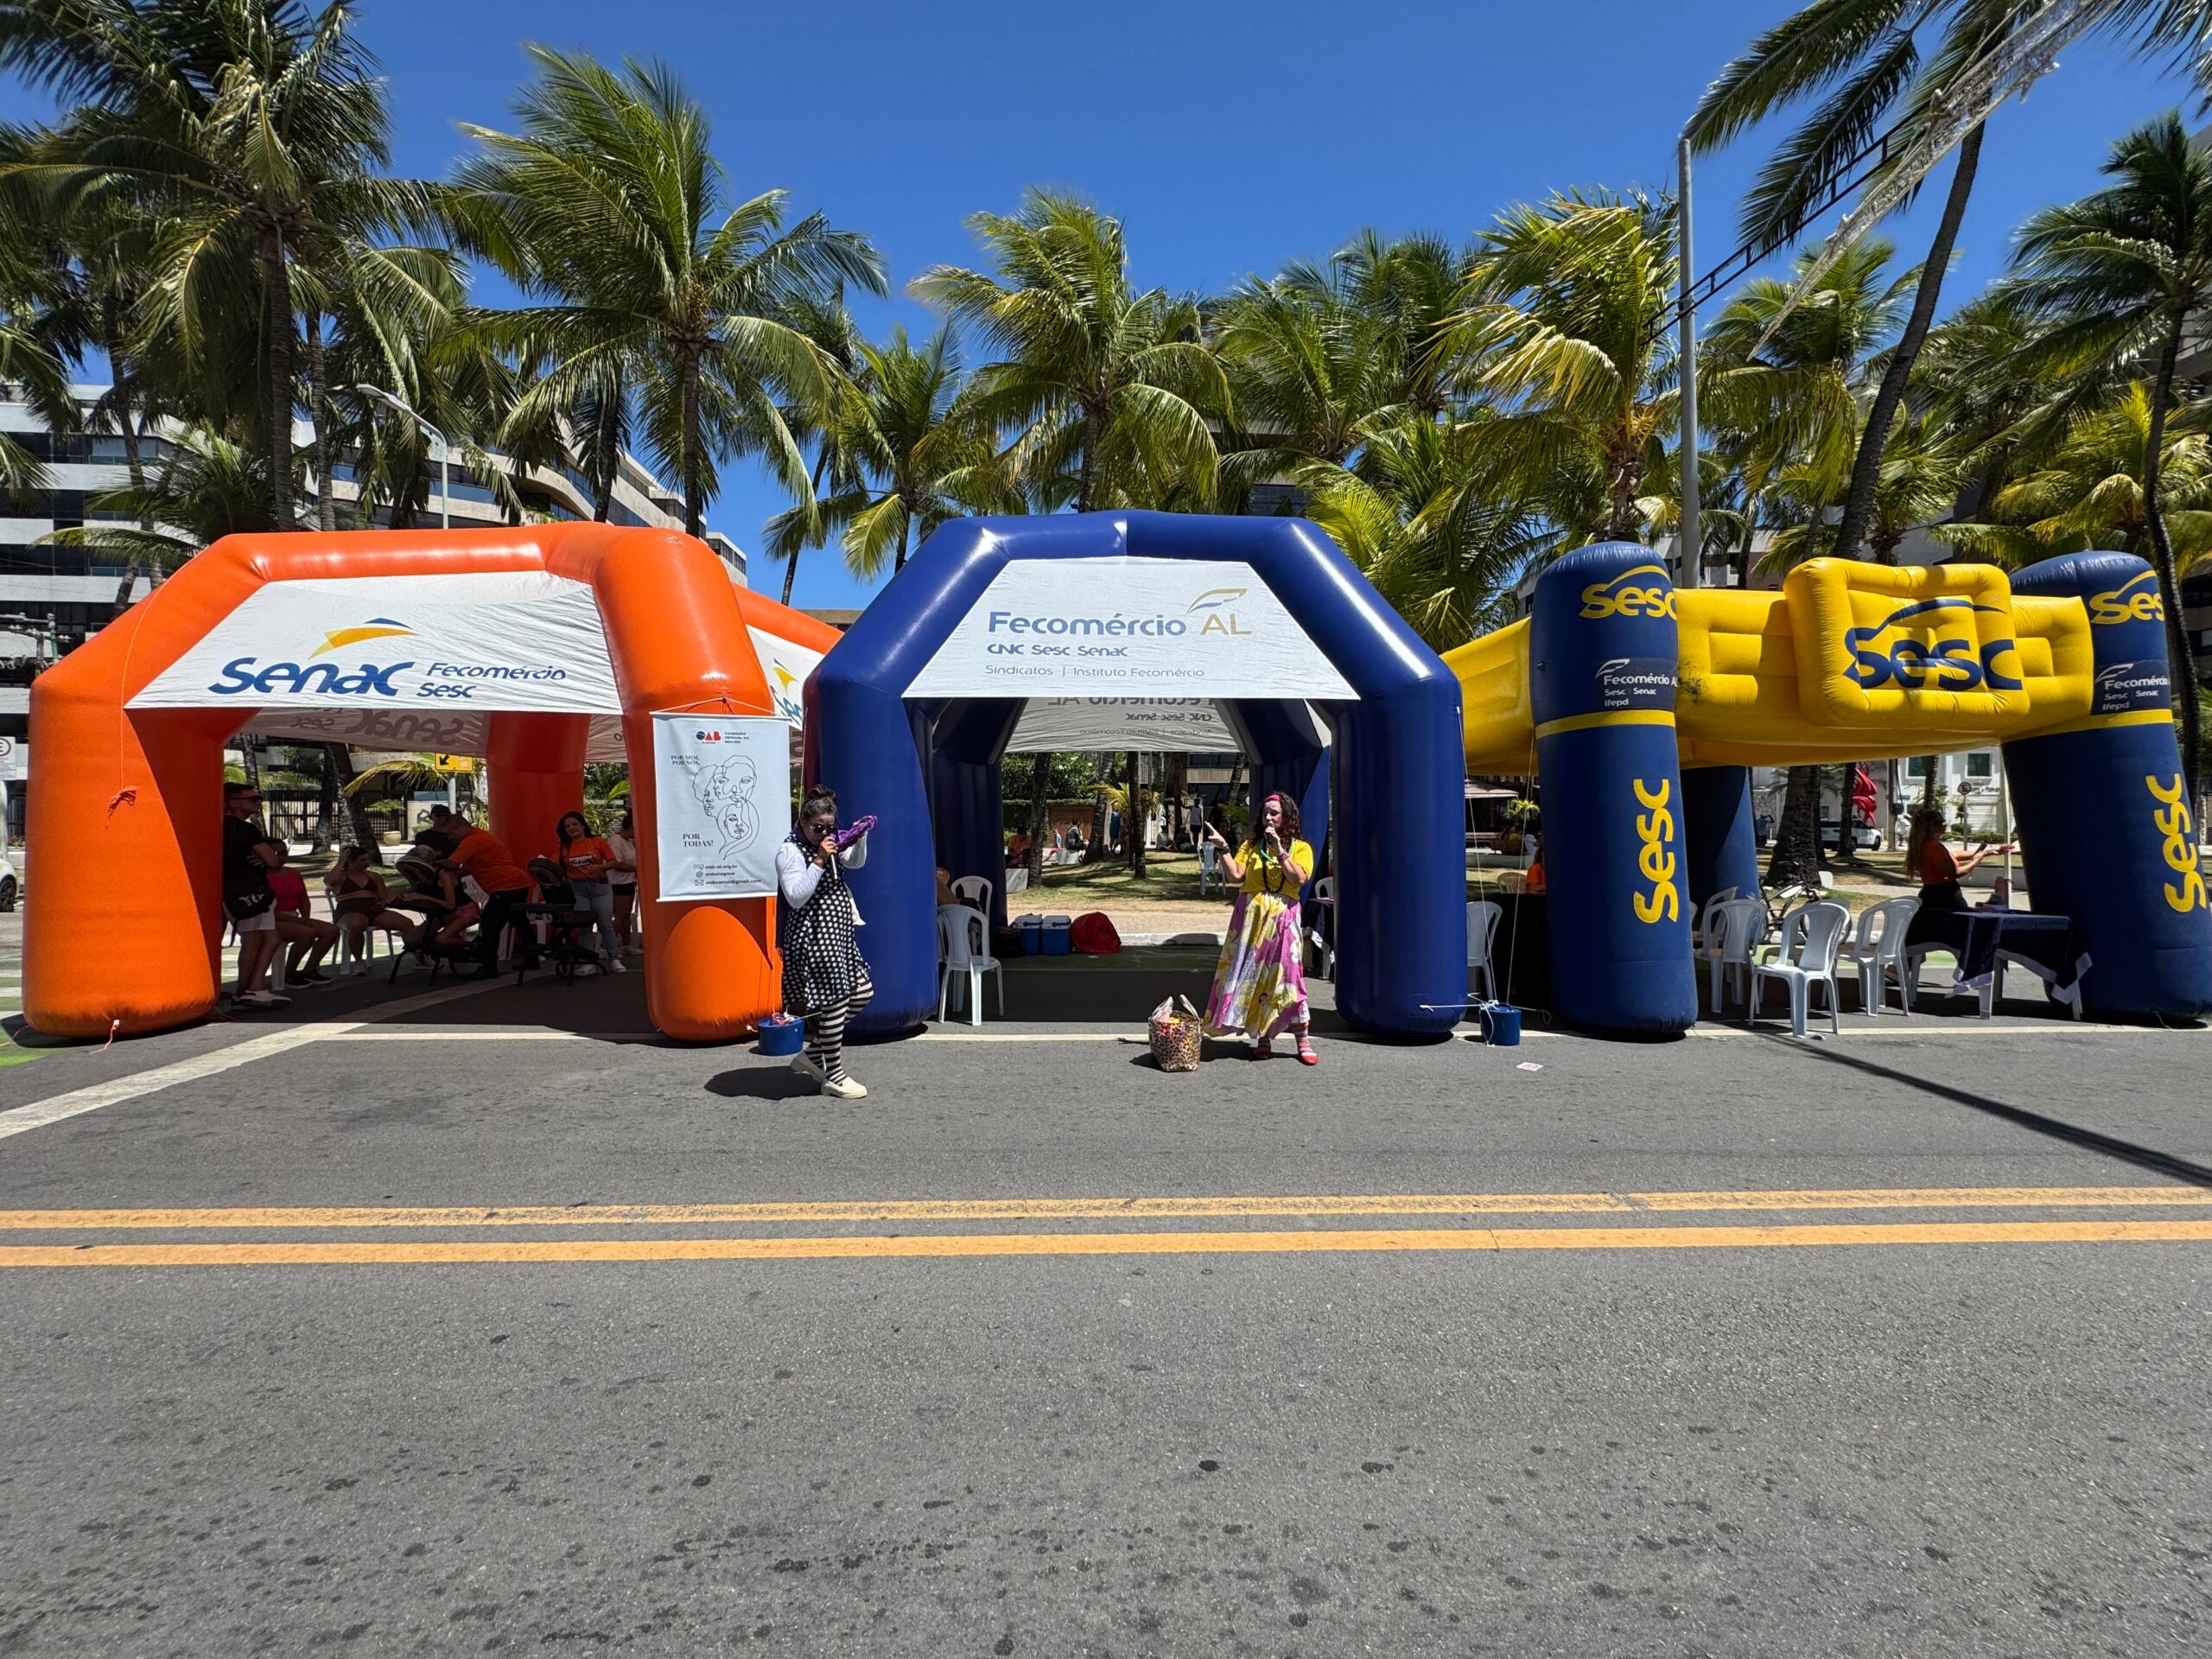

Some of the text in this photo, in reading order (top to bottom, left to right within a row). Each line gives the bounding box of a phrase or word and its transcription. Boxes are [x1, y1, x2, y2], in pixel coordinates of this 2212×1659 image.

[2089, 591, 2165, 625] Ses
[988, 611, 1252, 636] Fecomércio AL
[987, 643, 1128, 658] CNC Sesc Senac
[1842, 626, 2024, 691] Sesc
[207, 657, 416, 696] Senac
[426, 662, 567, 681] Fecomércio
[985, 664, 1205, 678] Sindicatos Instituto Fecomércio
[1603, 672, 1669, 686] Fecomércio
[416, 682, 477, 698] Sesc
[1632, 687, 1657, 696] Senac
[2104, 691, 2129, 701] Sesc
[683, 839, 714, 848] TODAS!
